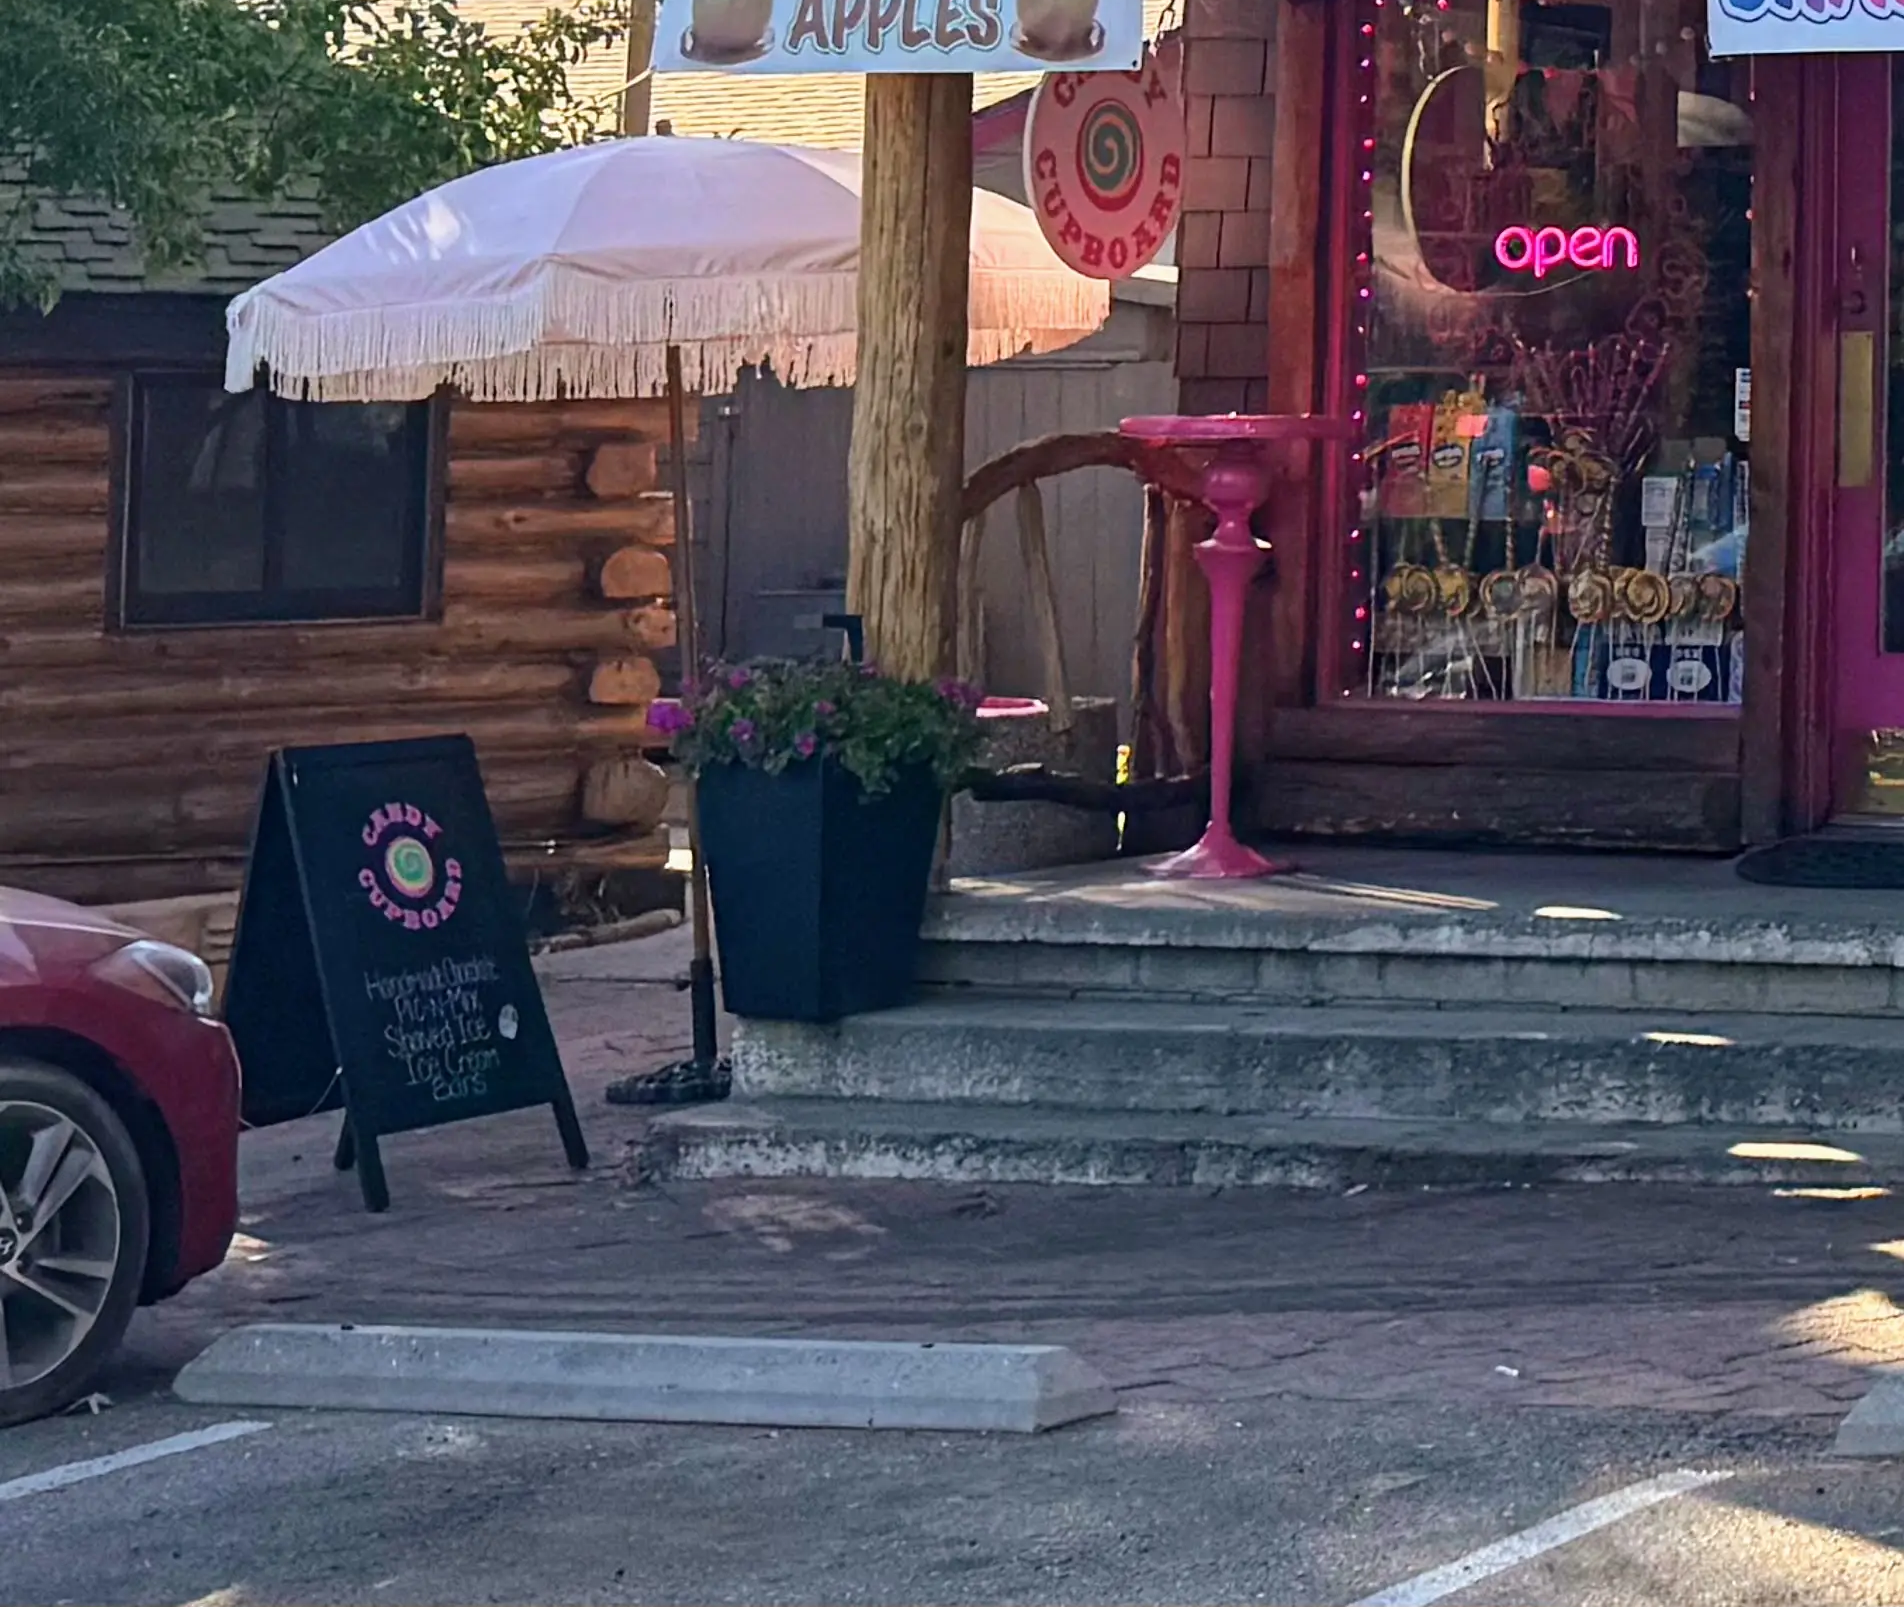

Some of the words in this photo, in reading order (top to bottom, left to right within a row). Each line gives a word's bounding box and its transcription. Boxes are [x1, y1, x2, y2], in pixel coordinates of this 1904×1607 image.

[1036, 148, 1180, 268] CUPBOARD
[1494, 225, 1639, 277] open
[362, 802, 443, 846] CANDY
[358, 858, 462, 930] CUPBOARD
